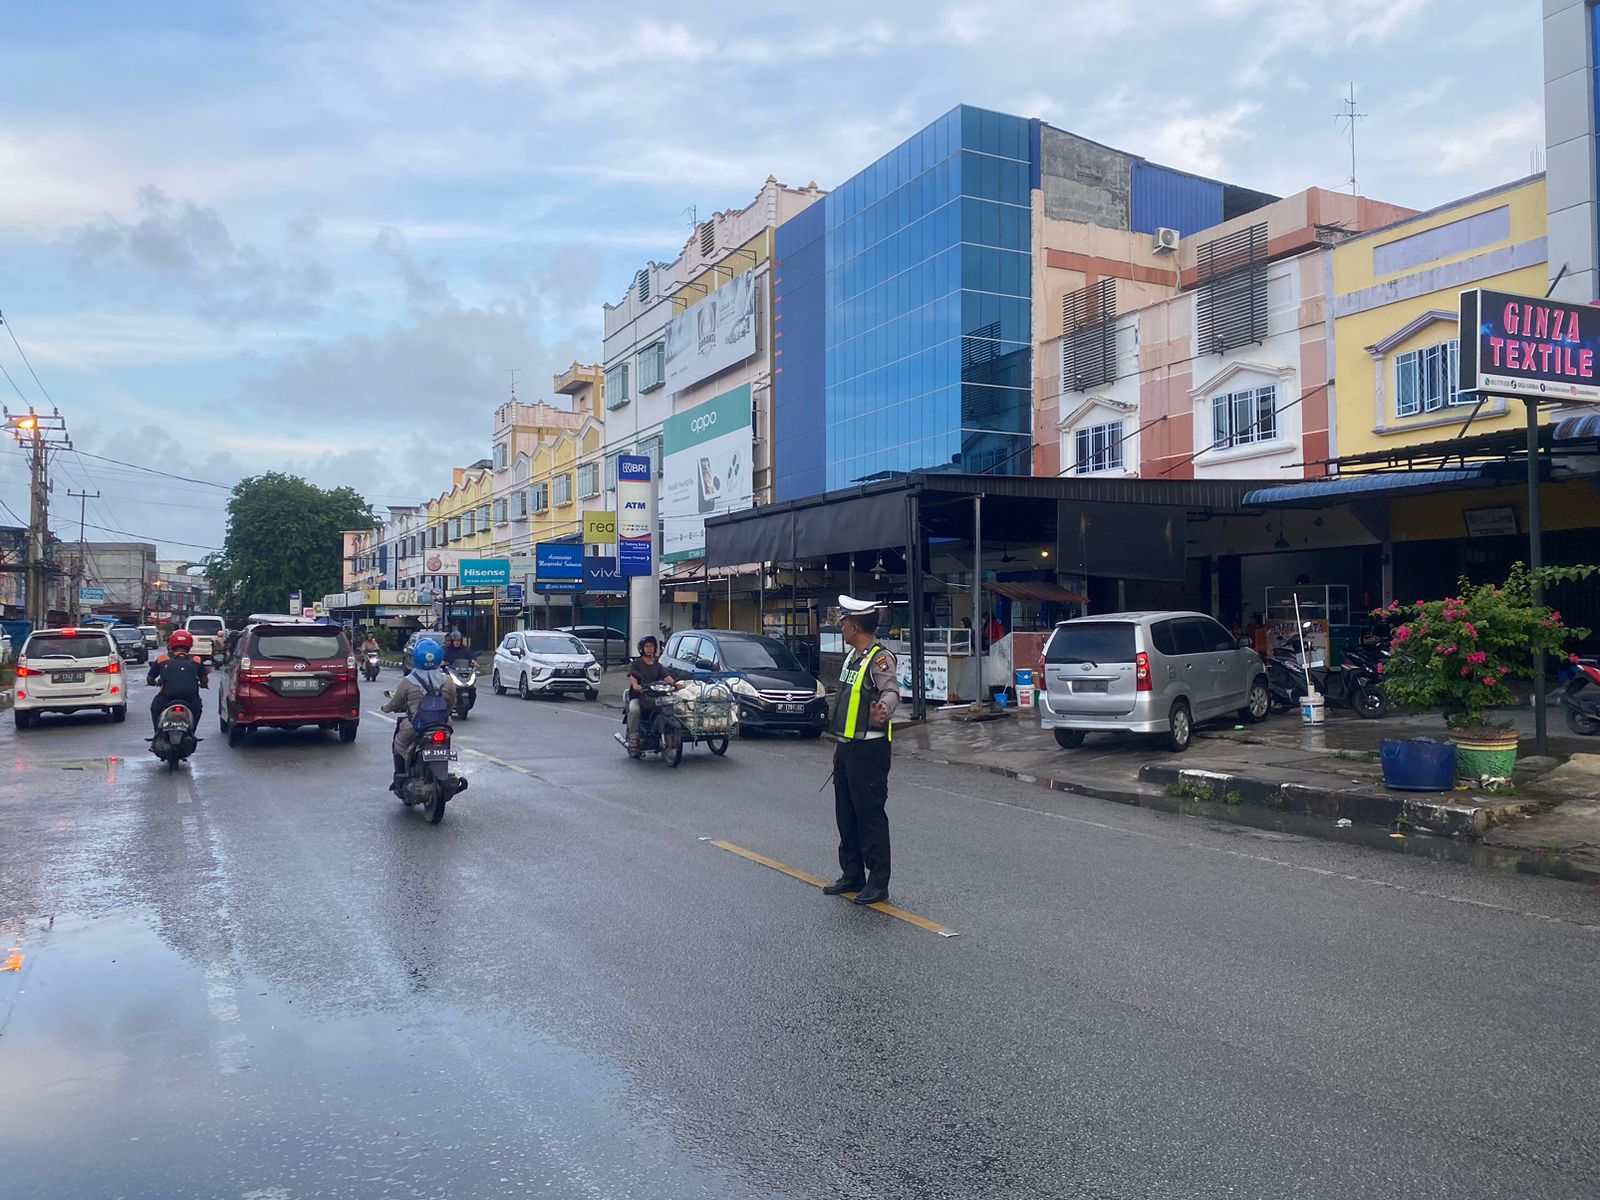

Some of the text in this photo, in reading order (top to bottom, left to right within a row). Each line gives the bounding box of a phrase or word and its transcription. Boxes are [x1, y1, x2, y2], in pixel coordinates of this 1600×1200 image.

[1503, 302, 1581, 343] GINZA
[1490, 337, 1593, 377] TEXTILE
[690, 410, 717, 434] oppo
[631, 463, 647, 473] BRI
[625, 502, 646, 510] ATM
[464, 568, 505, 576] Hisense
